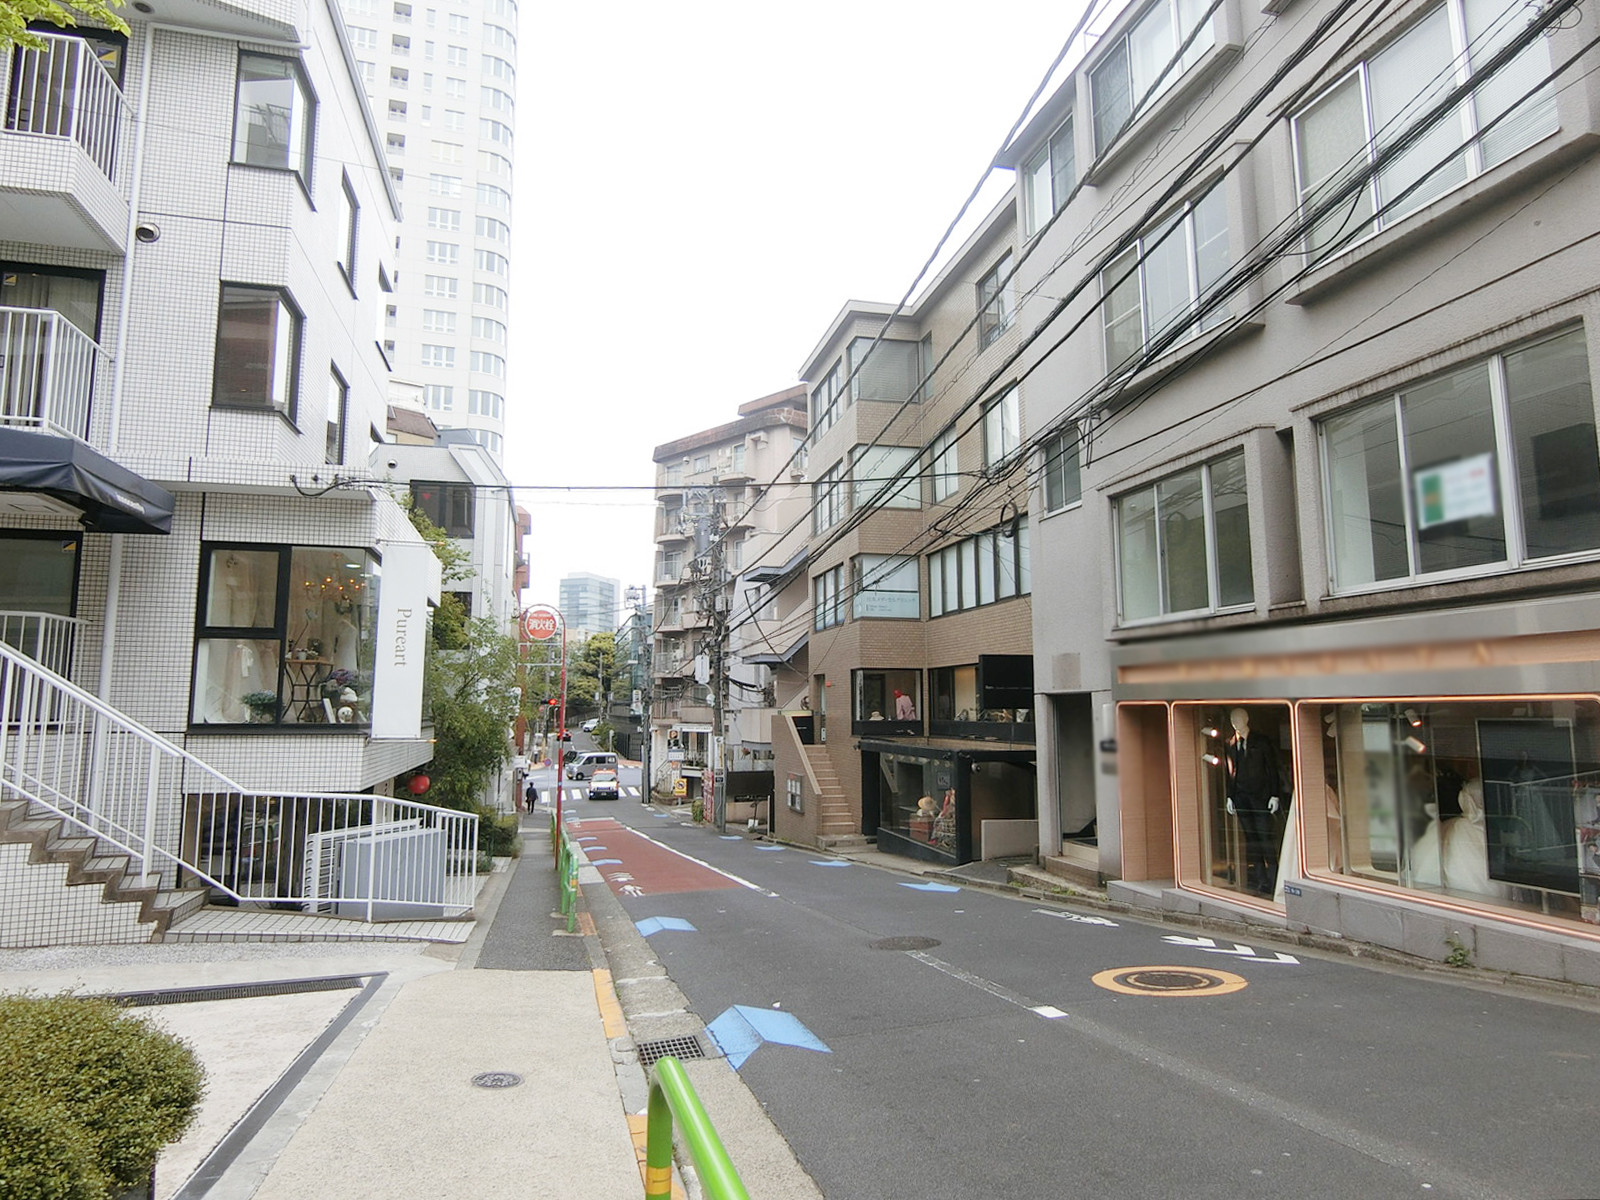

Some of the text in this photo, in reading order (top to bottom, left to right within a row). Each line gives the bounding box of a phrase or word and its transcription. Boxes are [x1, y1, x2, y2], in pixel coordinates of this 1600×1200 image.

[394, 608, 412, 667] Pureart
[529, 618, 554, 631] 消火栓
